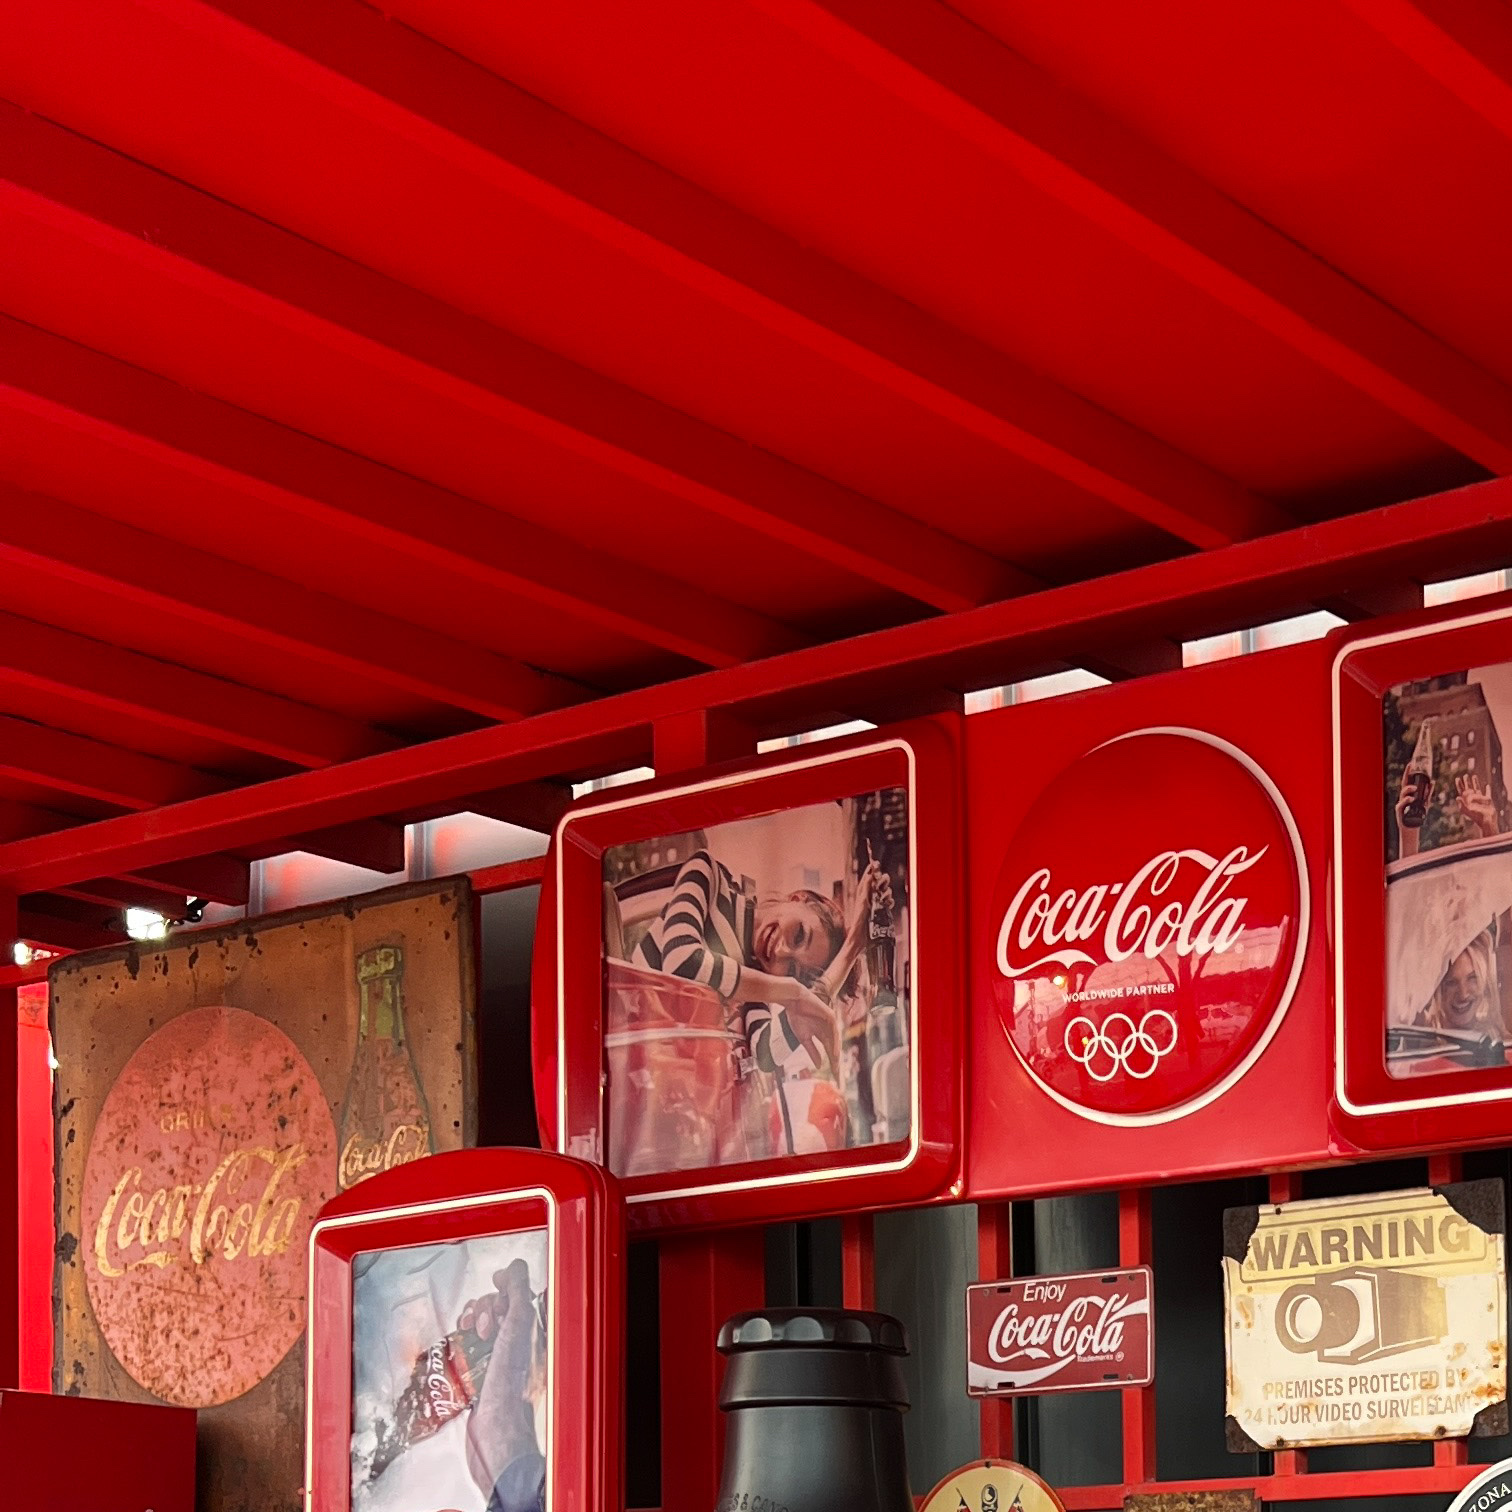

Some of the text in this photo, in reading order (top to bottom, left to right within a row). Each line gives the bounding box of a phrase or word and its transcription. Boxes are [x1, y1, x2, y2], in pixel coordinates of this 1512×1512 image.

[996, 843, 1270, 978] Coca-Cola
[1062, 983, 1175, 1003] WORLDWIDE PARTNER
[95, 1142, 308, 1278] Coca-Cola
[1250, 1214, 1471, 1272] WARNING
[1022, 1281, 1067, 1303] Enjoy
[987, 1293, 1130, 1364] Coca-Cola
[1264, 1377, 1344, 1400] PREMISES
[1350, 1370, 1440, 1395] PROTECTED
[1314, 1400, 1362, 1424] VIDEO
